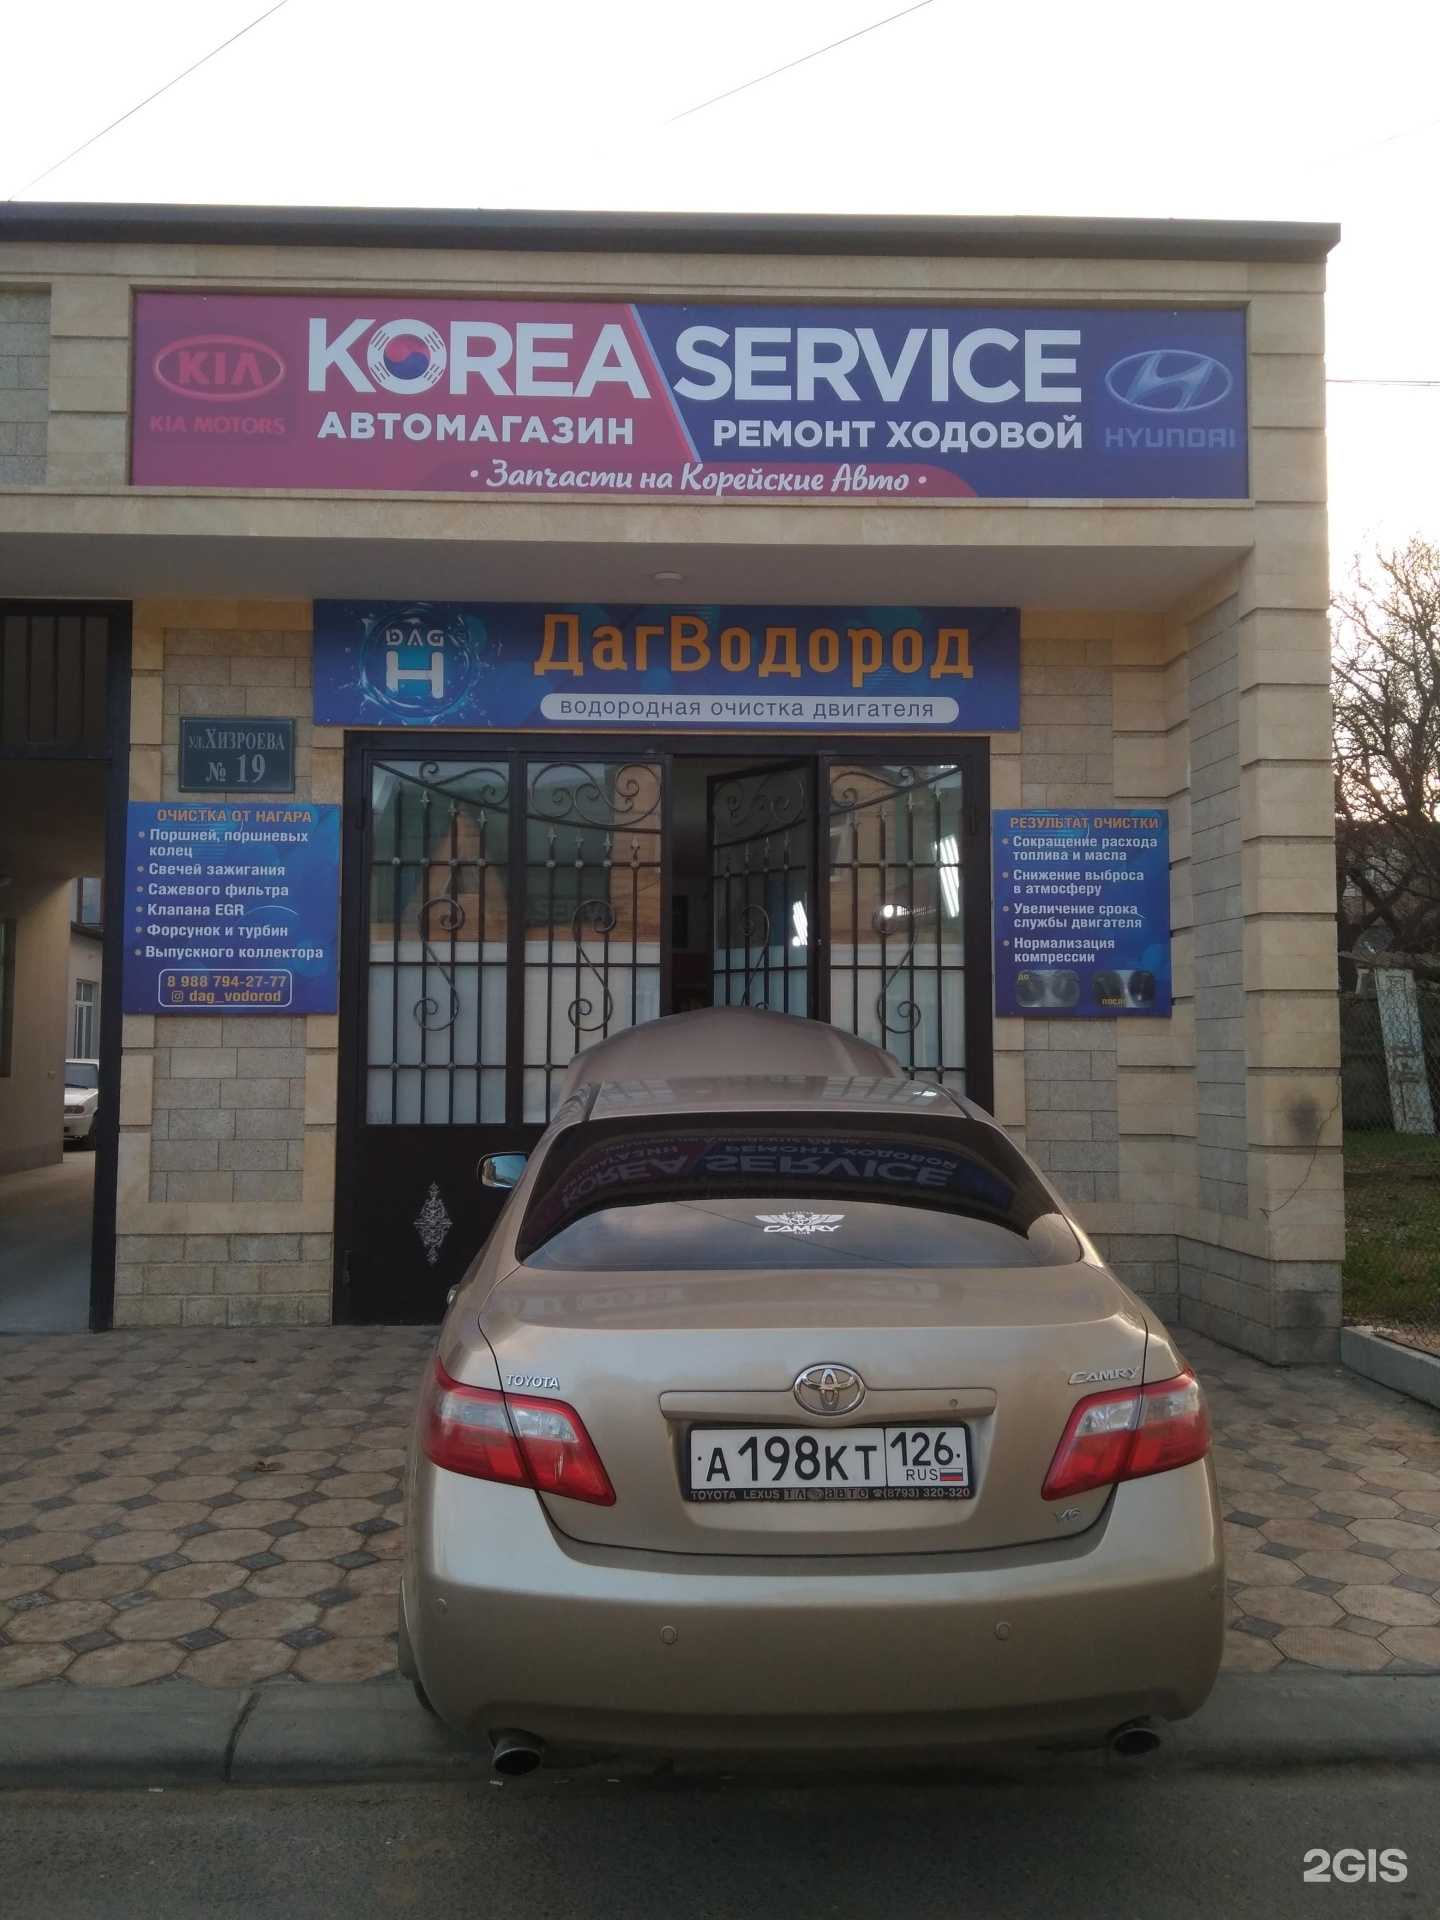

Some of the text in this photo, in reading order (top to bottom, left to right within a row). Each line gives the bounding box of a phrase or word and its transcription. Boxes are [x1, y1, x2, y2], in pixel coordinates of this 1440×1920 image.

[307, 318, 652, 400] KOREA
[673, 325, 1083, 404] SERVICE
[178, 351, 262, 388] KIA
[149, 416, 286, 435] KIA MOTORS
[316, 411, 634, 445] АВТОМАГАЗИН
[713, 414, 1083, 453] РЕМОНТ ХОДОВОЙ
[1103, 428, 1236, 449] HYUNDAI
[486, 459, 909, 498] Запчасти на Корейские Авто
[533, 612, 975, 689] ДагВодород
[559, 698, 934, 720] водородная очистка двигателя
[236, 753, 266, 784] 19
[156, 809, 312, 823] ОЧИСТКА ОТ НАГАРА
[1009, 817, 1159, 829] РЕЗУЛЬТАТ ОЧИСТКИ
[149, 828, 309, 845] Поршней, поршневых
[1012, 835, 1158, 849] Сокращение расхода
[149, 846, 193, 858] колец
[1013, 851, 1127, 861] топлива и масла
[148, 862, 286, 876] Свечей зажигания
[1013, 869, 1145, 883] Снижение выброса
[148, 883, 289, 898] Сажевого фильтра
[1013, 884, 1102, 896] в атмосферу
[147, 903, 245, 916] Клапана EGR
[1013, 903, 1138, 916] Увеличение срока
[1013, 916, 1142, 930] службы двигателя
[146, 923, 288, 939] Форсунок и турбин
[1013, 937, 1115, 951] Нормализация
[145, 946, 324, 961] Выпускного коллектора
[1013, 952, 1096, 964] компрессии
[167, 975, 288, 988] 8 988 794-27-77
[188, 990, 281, 1004] dag_vodorod
[762, 1223, 842, 1234] CAMRY
[506, 1374, 560, 1390] TOYOTA
[1068, 1367, 1139, 1385] CAMRY
[889, 1431, 954, 1467] 126
[905, 1468, 939, 1481] RUS
[690, 1489, 737, 1500] TOYOTA
[743, 1489, 780, 1499] LEXUS
